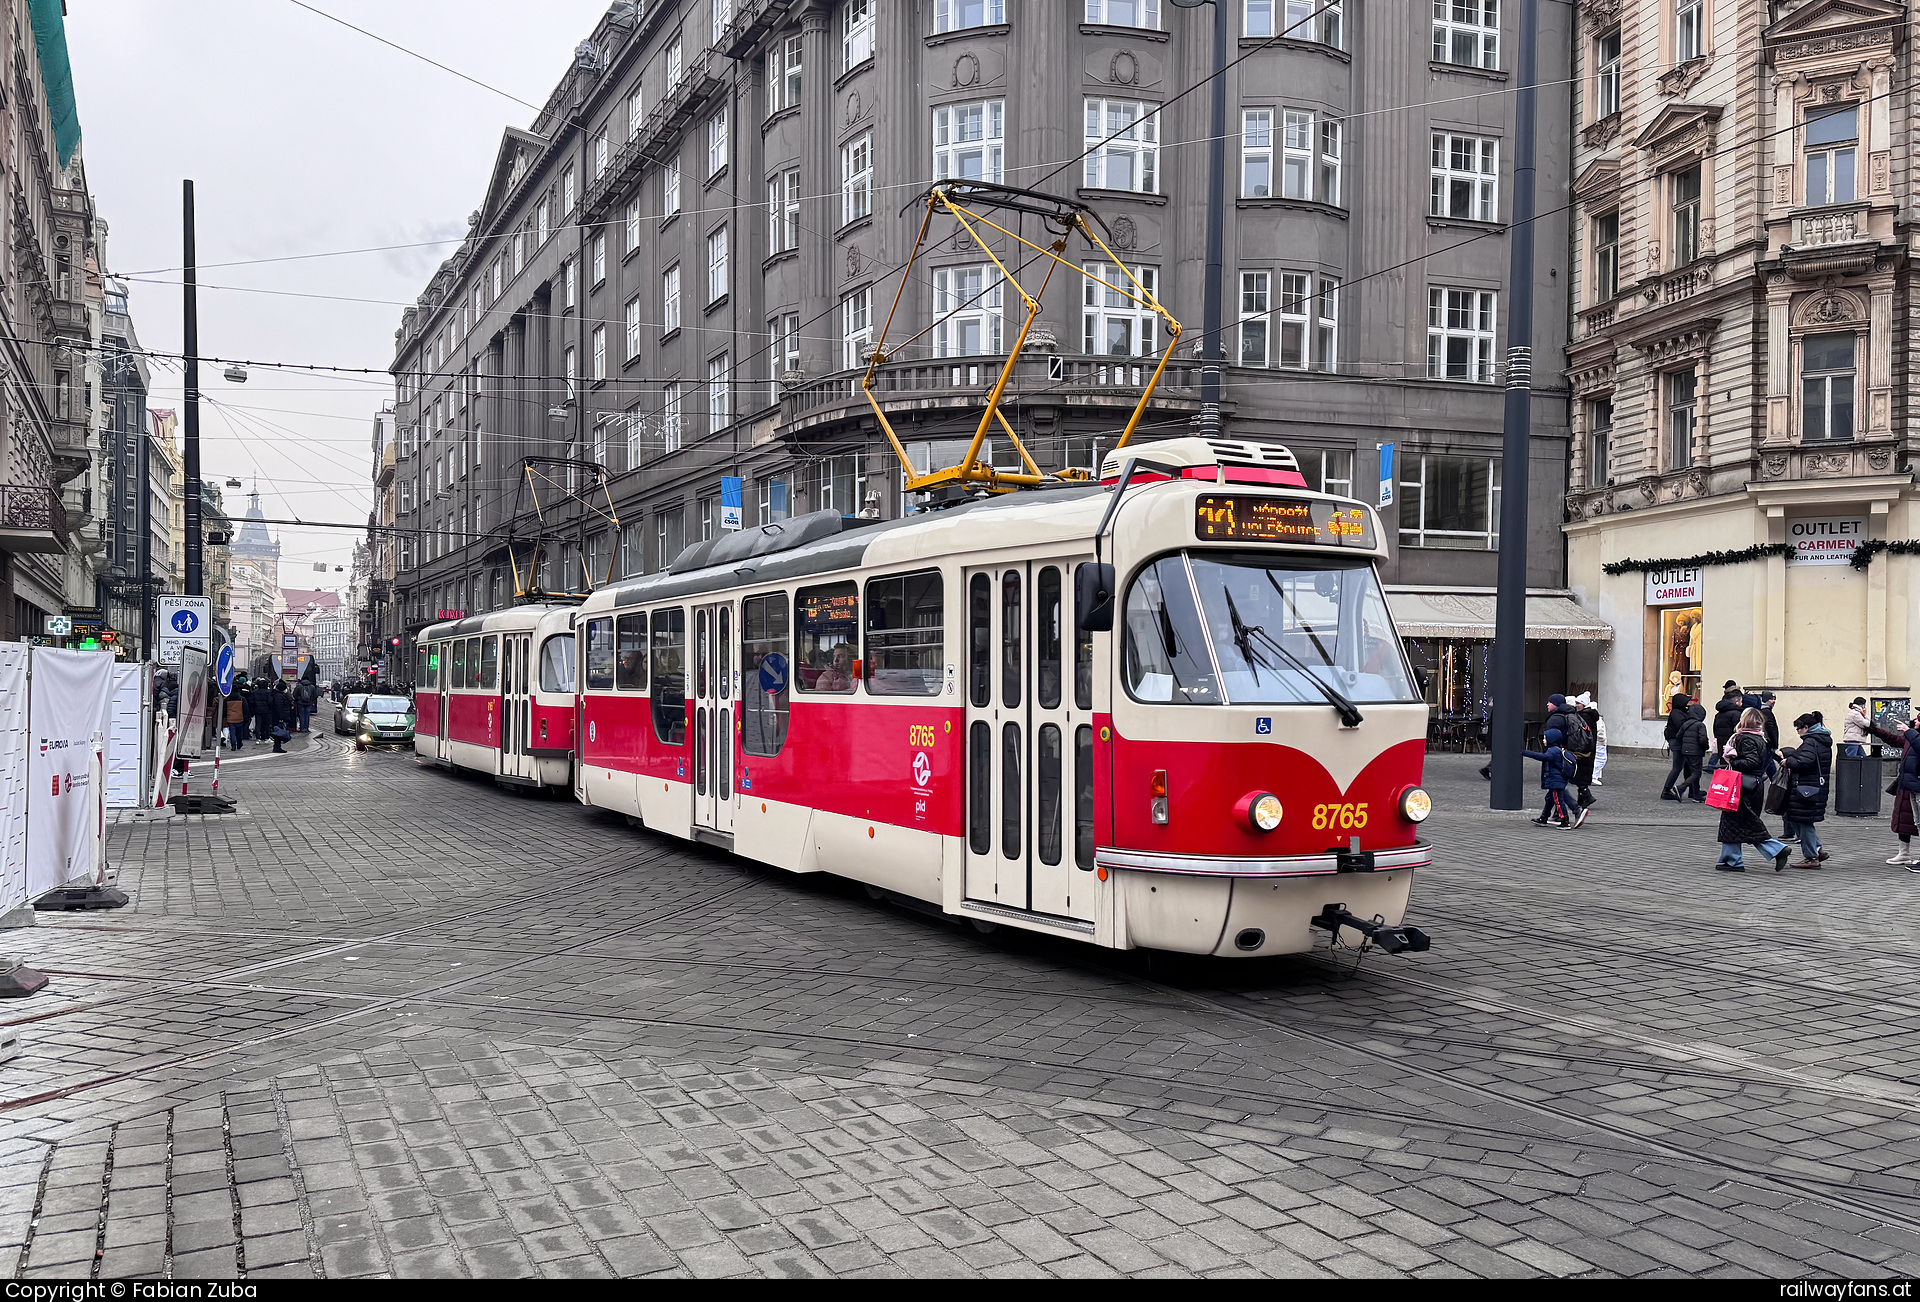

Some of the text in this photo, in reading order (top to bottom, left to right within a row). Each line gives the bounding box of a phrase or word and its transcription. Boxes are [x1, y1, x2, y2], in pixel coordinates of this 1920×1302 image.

[1791, 521, 1862, 536] OUTLET
[1797, 539, 1856, 550] CARMEN
[1652, 568, 1700, 585] OUTLET
[1655, 586, 1695, 599] CARMEN
[164, 599, 205, 608] PĚŠÍ ZÓNA
[909, 725, 935, 748] 8765
[1312, 802, 1368, 830] 8765
